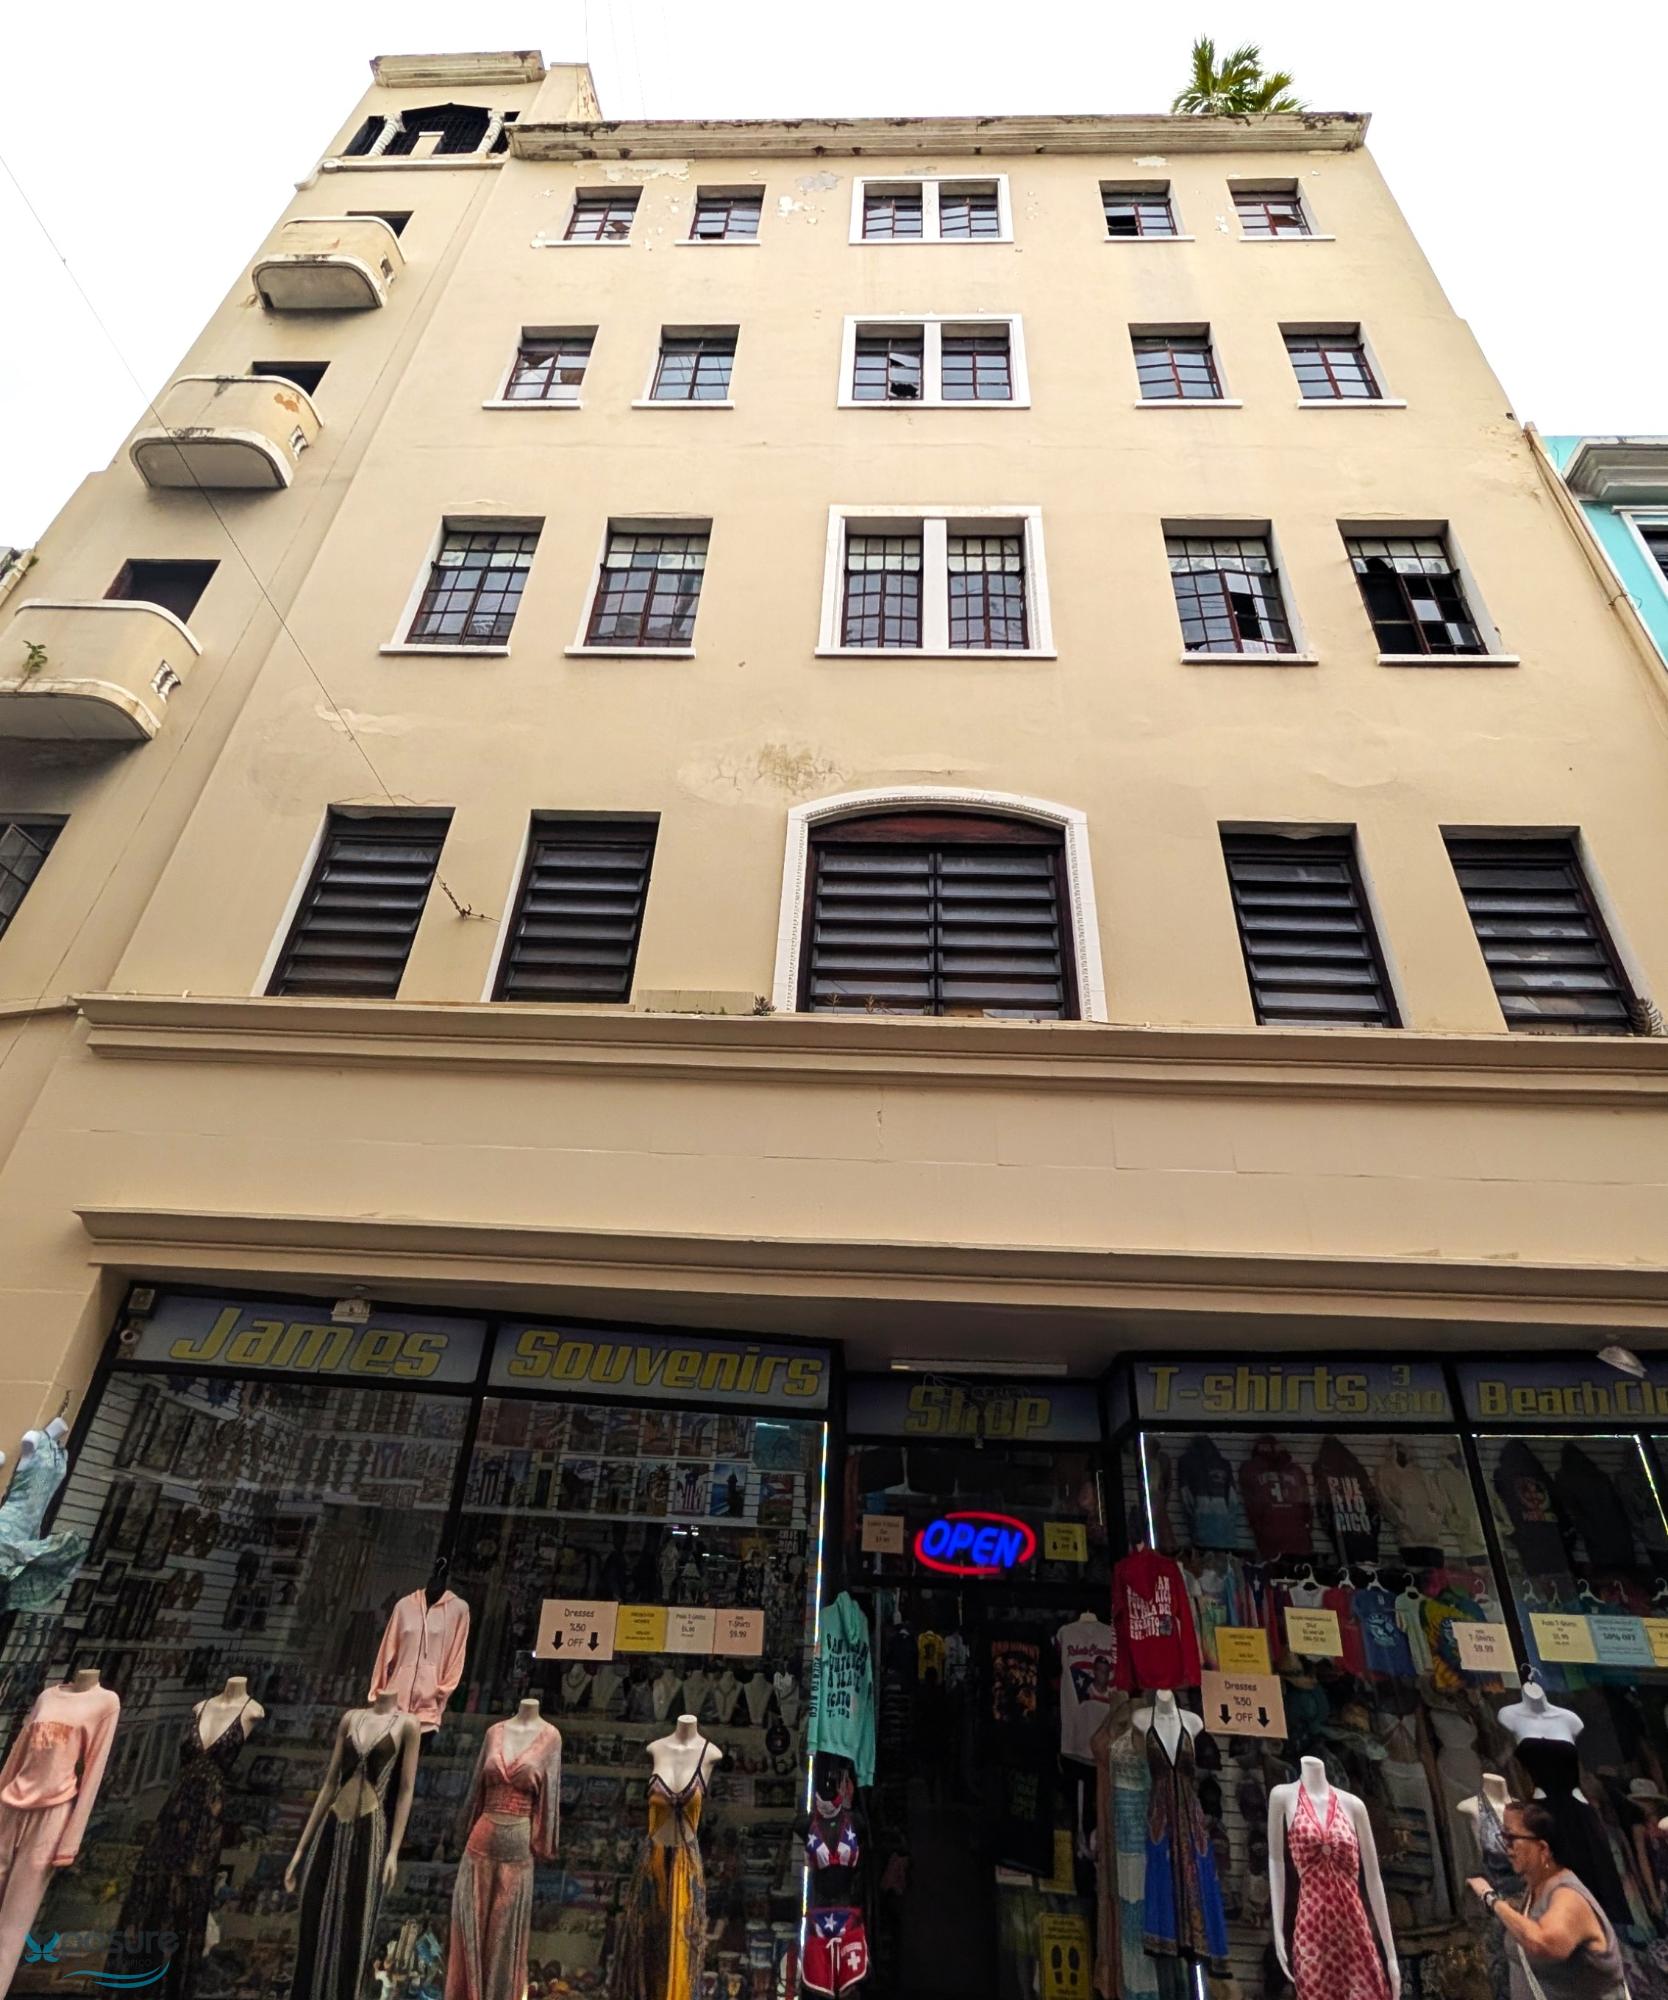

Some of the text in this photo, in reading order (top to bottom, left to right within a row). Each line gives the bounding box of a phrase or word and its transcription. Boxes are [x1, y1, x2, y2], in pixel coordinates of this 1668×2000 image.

[169, 1307, 823, 1397] James Souvenirs
[1391, 1364, 1411, 1387] 3
[1148, 1365, 1369, 1413] T-shirts
[1478, 1380, 1610, 1416] Beach
[903, 1384, 1051, 1439] Shop
[922, 1519, 1023, 1569] OPEN
[564, 1607, 594, 1618] Dresses
[569, 1623, 586, 1632] %50
[728, 1620, 751, 1628] T-Shirts
[729, 1630, 747, 1639] $9.99
[567, 1638, 585, 1647] OFF
[1224, 1680, 1258, 1692] Dresses
[1233, 1696, 1252, 1706] %50
[1235, 1712, 1253, 1722] OFF
